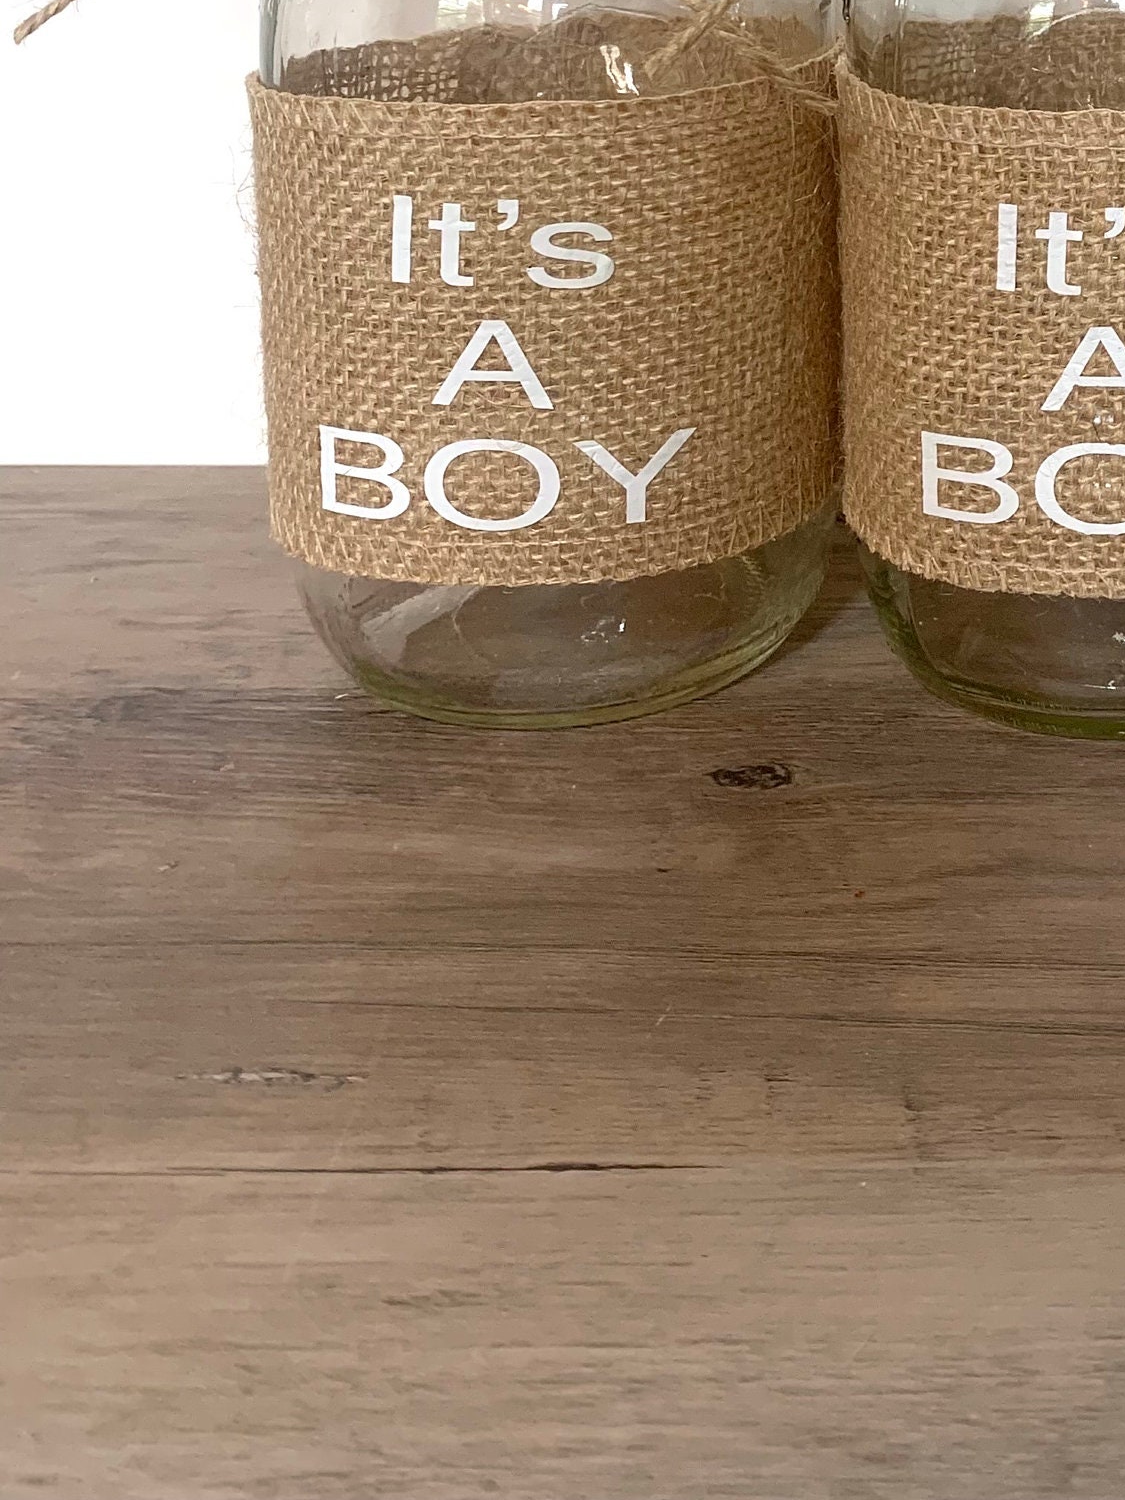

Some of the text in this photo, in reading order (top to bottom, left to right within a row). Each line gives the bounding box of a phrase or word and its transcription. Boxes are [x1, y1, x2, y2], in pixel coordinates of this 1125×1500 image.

[389, 194, 615, 290] It's
[431, 319, 554, 410] A
[318, 423, 696, 532] BOY
